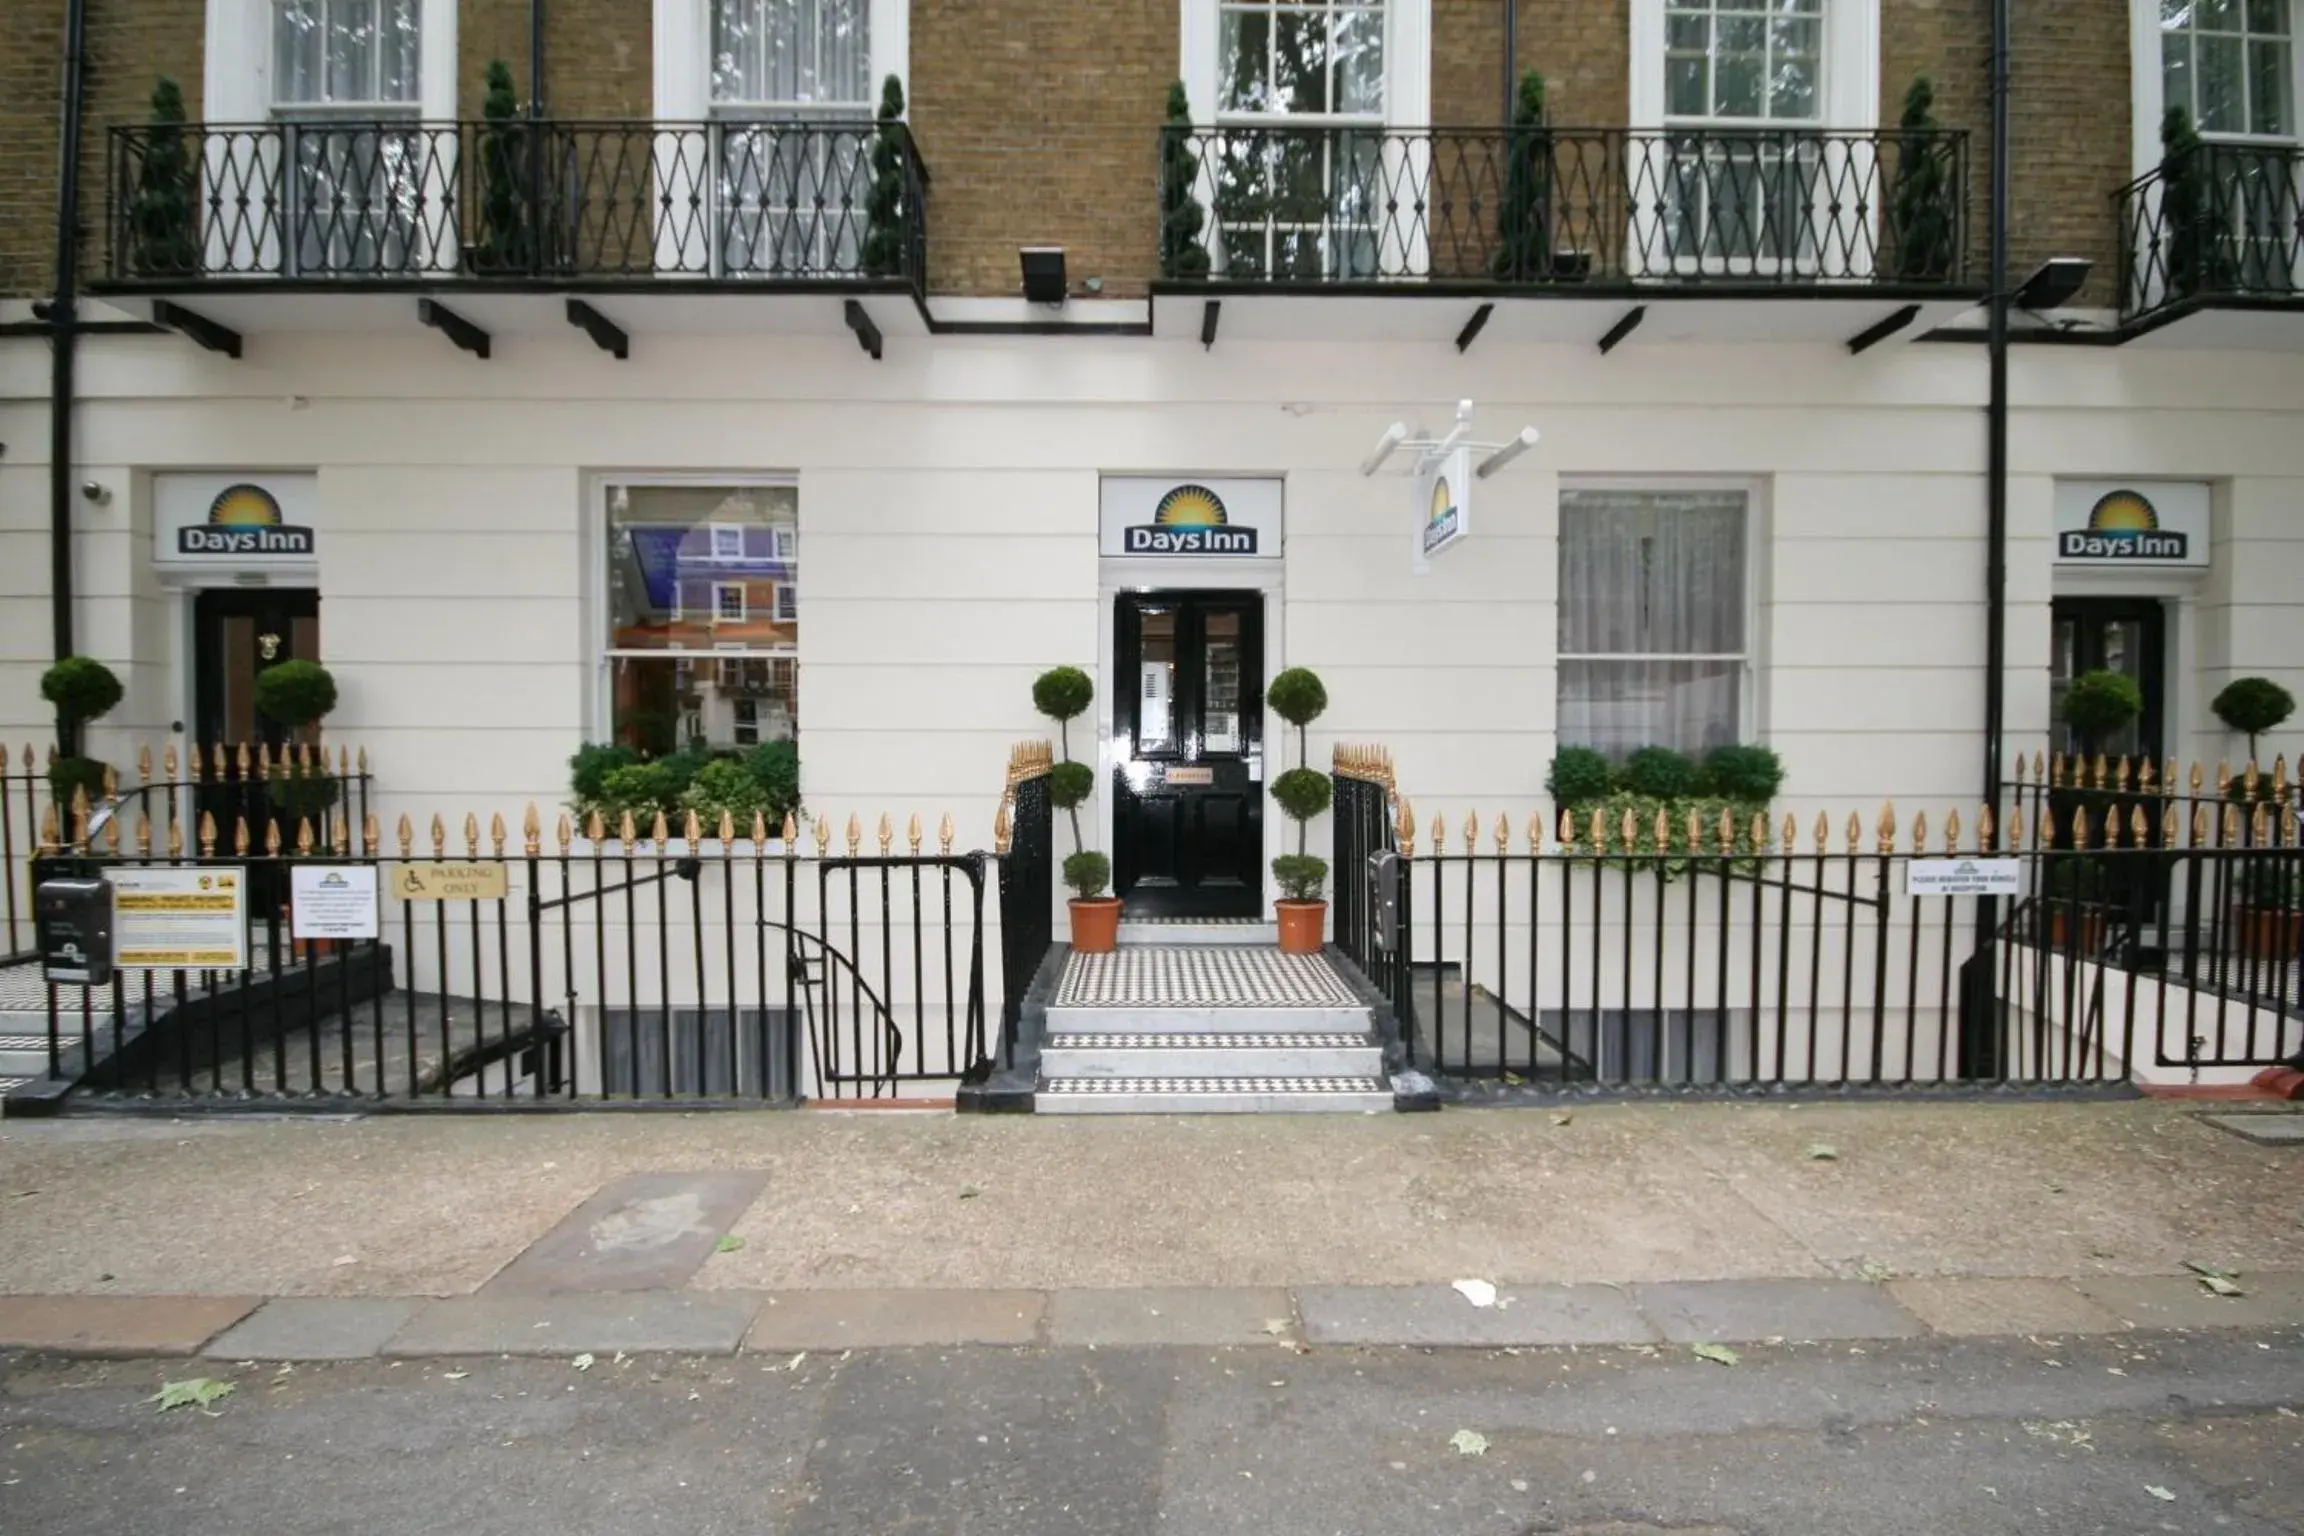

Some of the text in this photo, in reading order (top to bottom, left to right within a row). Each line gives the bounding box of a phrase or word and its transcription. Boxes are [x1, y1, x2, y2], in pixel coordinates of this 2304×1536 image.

[186, 529, 306, 551] Days Inn
[1132, 529, 1250, 551] Days Inn
[2066, 534, 2180, 556] Days Inn
[430, 867, 492, 878] PARKING
[443, 883, 478, 893] ONLY
